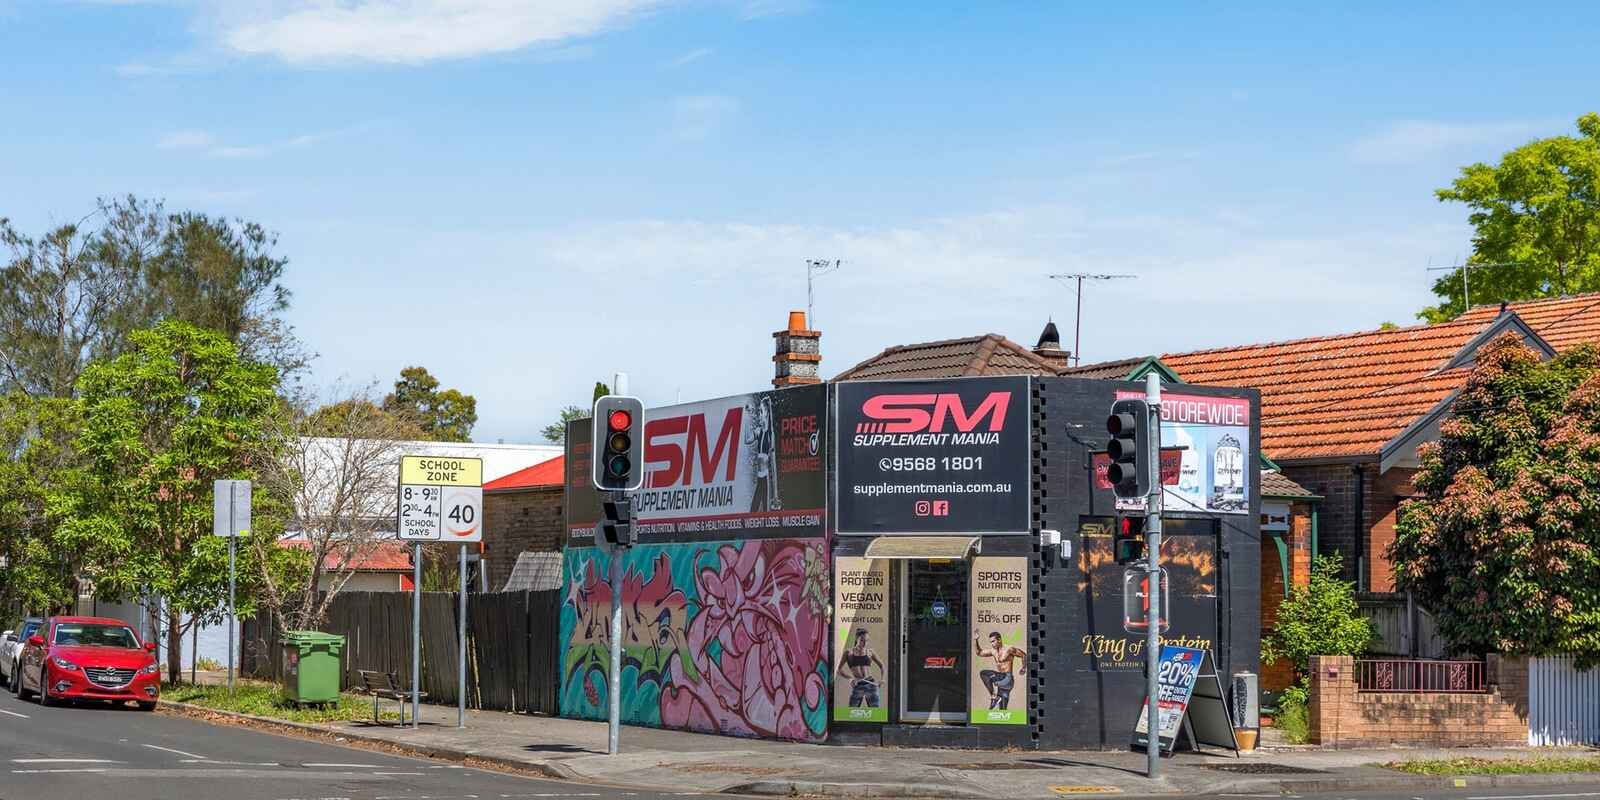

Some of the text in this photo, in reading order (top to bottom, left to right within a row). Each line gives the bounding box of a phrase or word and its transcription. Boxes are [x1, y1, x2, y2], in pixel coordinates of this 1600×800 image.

[857, 392, 1011, 433] SM
[1161, 400, 1244, 425] STOREWIDE
[781, 416, 817, 434] PRICE
[781, 437, 810, 454] MATCH
[853, 433, 1000, 446] SUPPLEMENT MANIA
[643, 407, 744, 489] SM
[419, 460, 465, 471] SCHOOL
[892, 457, 983, 471] 9568 1801
[427, 472, 457, 482] ZONE
[853, 482, 1012, 496] supplementmania.com.au
[697, 486, 733, 508] MANIA
[448, 505, 475, 524] 40
[744, 517, 764, 529] WEIGHT
[782, 515, 805, 527] MUSCLE
[806, 514, 820, 526] GAIN
[404, 519, 436, 528] SCHOOL
[841, 577, 884, 586] PROTEIN
[978, 571, 1022, 581] SPORTS
[978, 582, 1022, 590] NUTRITION
[841, 593, 883, 602] VEGAN
[977, 614, 1022, 623] 50% OFF
[1082, 635, 1127, 661] King
[1128, 640, 1145, 656] of
[925, 657, 957, 666] SM
[1158, 661, 1194, 687] 20%
